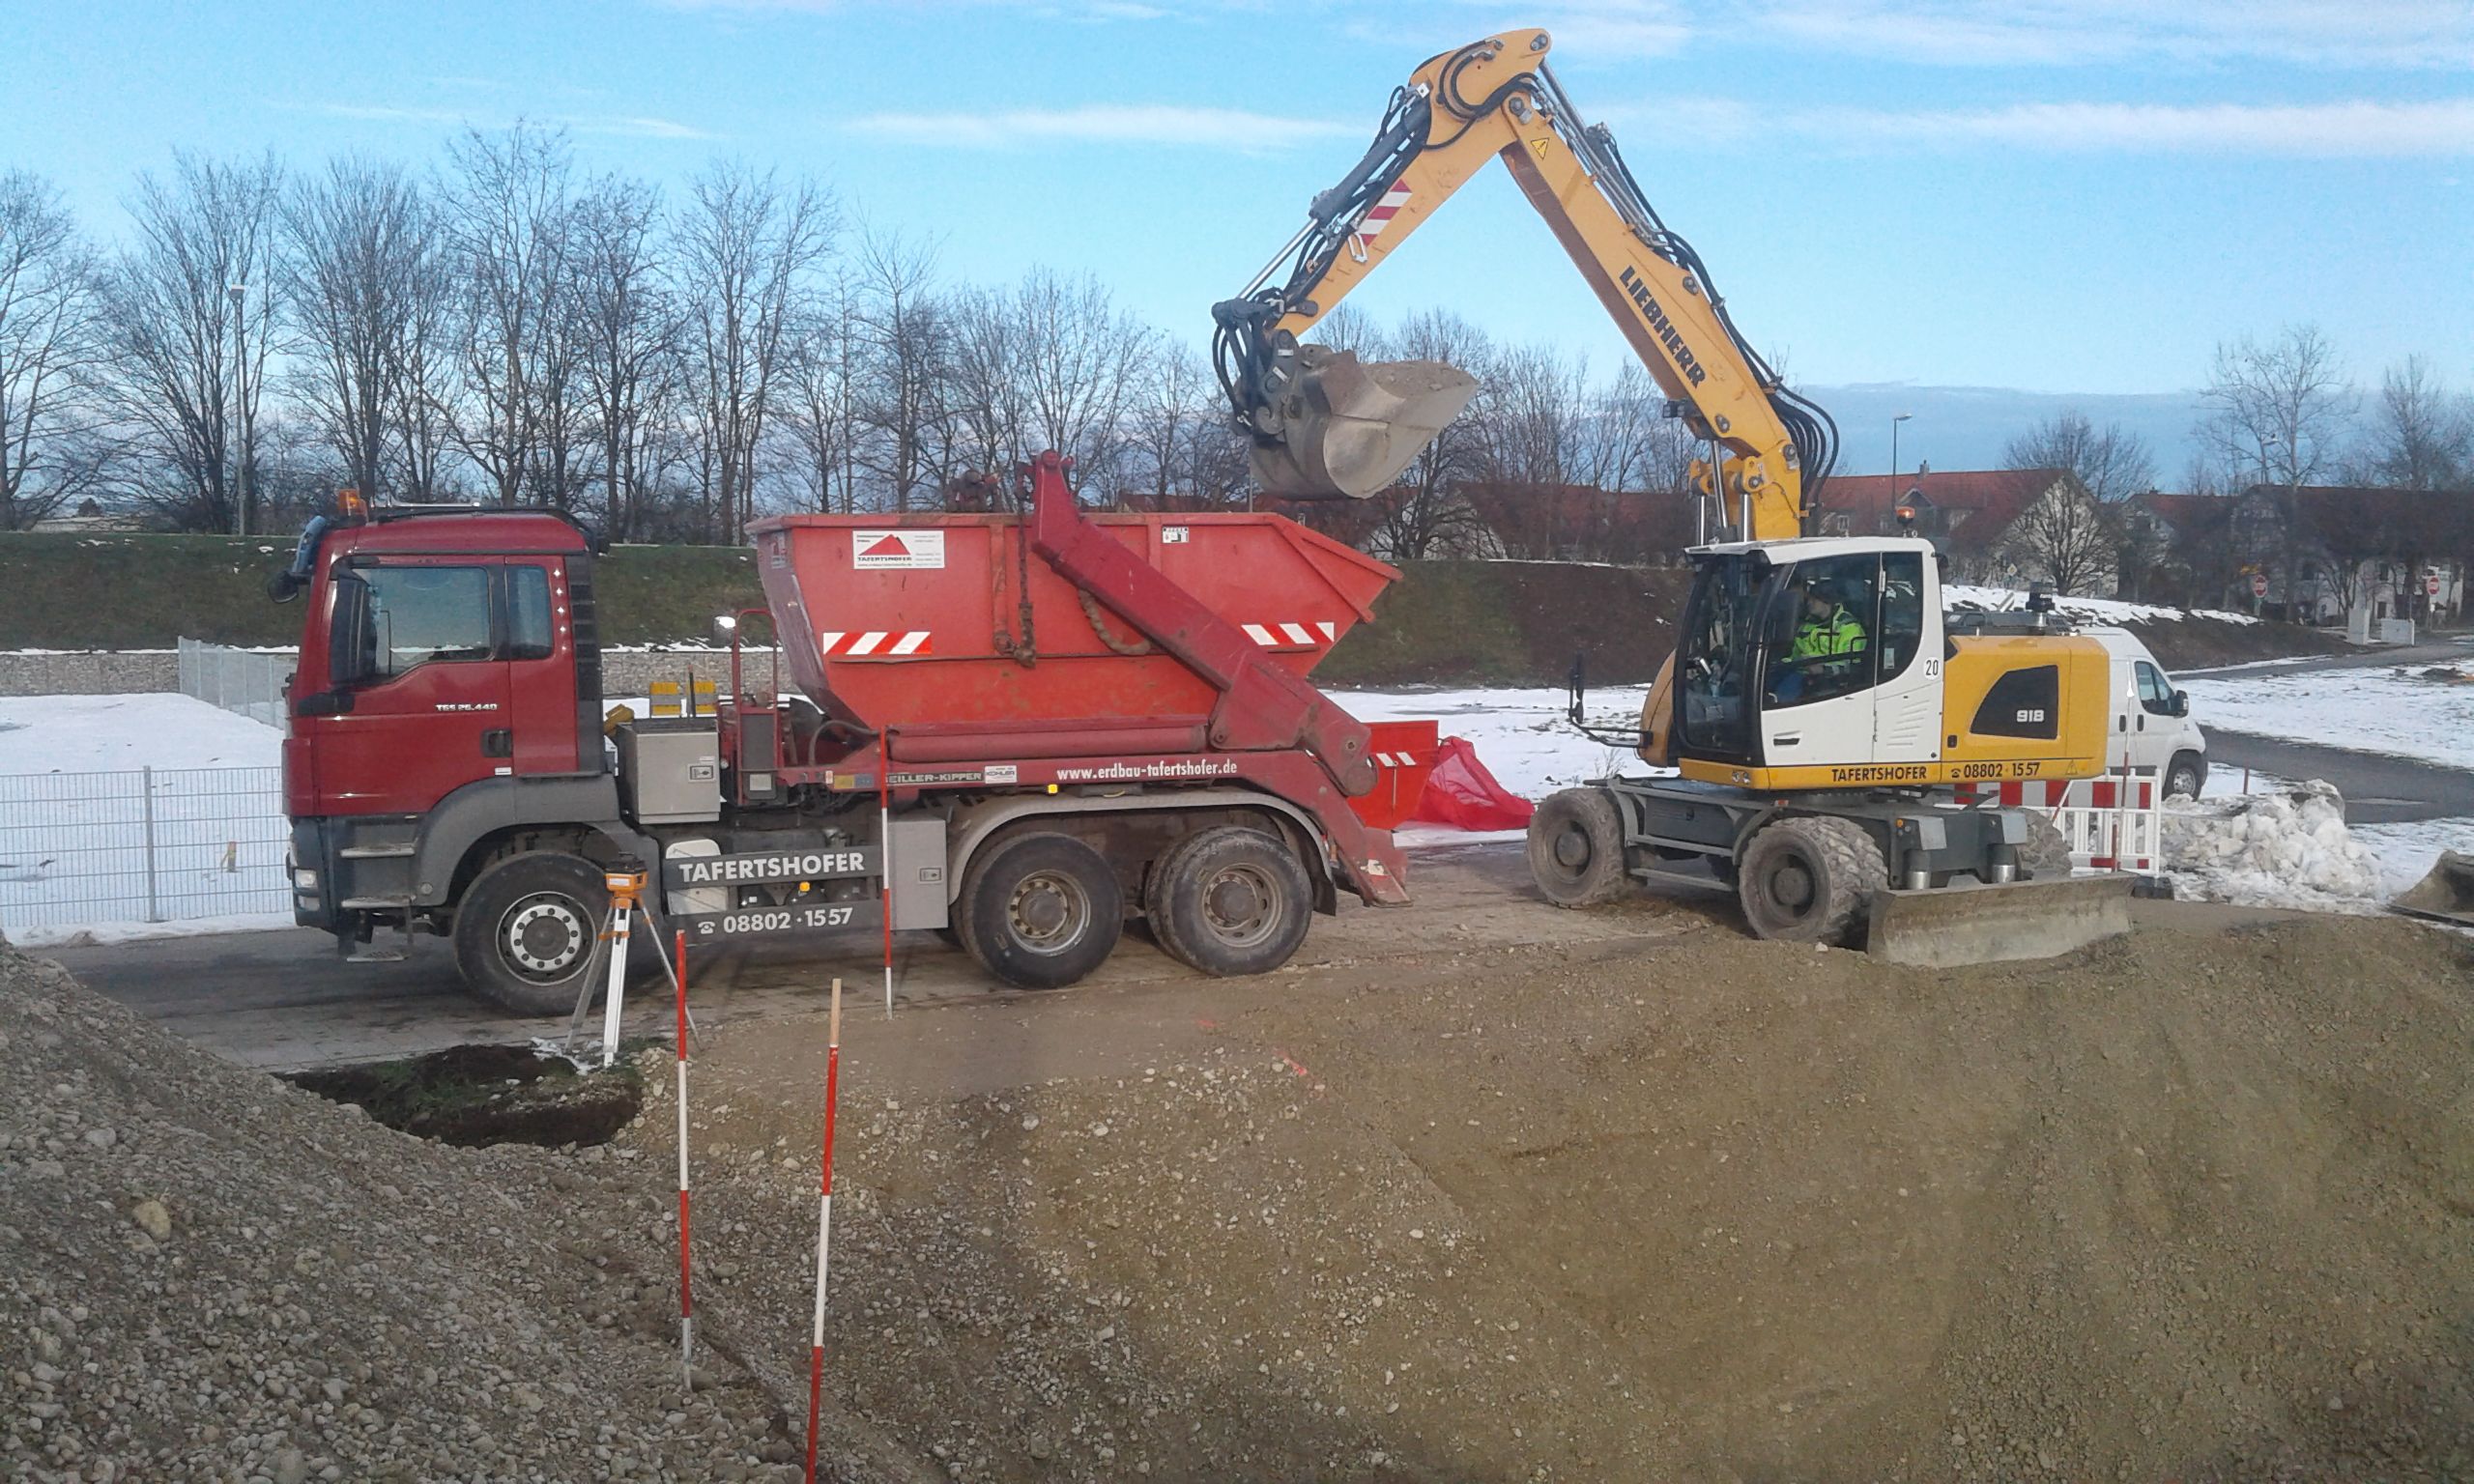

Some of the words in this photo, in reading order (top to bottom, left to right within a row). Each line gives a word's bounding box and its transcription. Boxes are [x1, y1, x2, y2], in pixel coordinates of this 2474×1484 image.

[1620, 266, 1706, 388] LIEBHERR
[1926, 660, 1939, 675] 20
[2017, 710, 2044, 722] 918
[1057, 758, 1237, 781] www.erdbau-tafertshofer.de
[1831, 766, 1927, 782] TAFERTSHOFER
[1964, 763, 2003, 778] 08802
[2012, 762, 2041, 777] 1557
[885, 773, 982, 784] EILLER-KIPPER
[678, 852, 865, 882] TAFERTSHOFER
[724, 912, 791, 933] 08802
[805, 907, 853, 928] 1557
